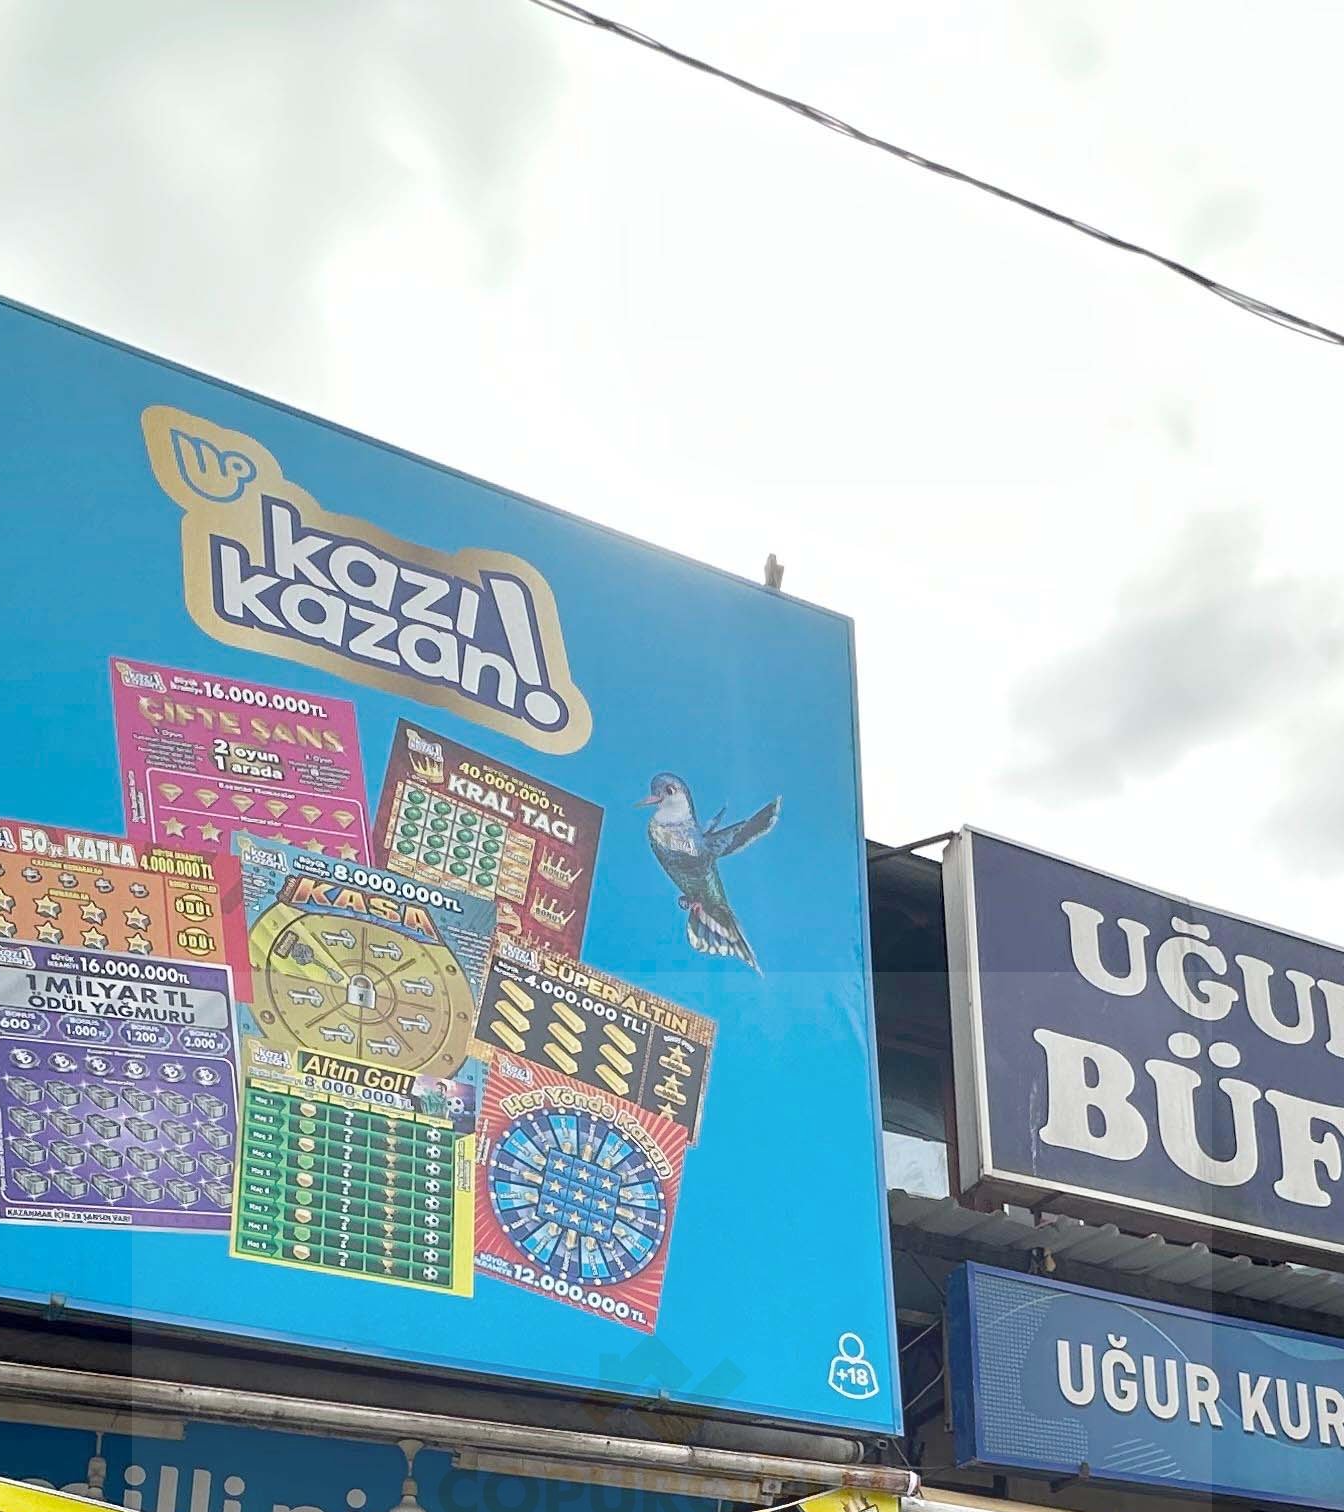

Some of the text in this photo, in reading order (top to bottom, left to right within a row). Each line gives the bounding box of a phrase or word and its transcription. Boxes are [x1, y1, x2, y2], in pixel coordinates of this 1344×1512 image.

[268, 500, 477, 636] kazı
[214, 739, 280, 764] 2 oyun
[214, 755, 225, 771] 1
[231, 764, 283, 781] arada
[459, 761, 550, 809] 40.000.000
[449, 774, 515, 819] KRAL
[521, 805, 577, 844] TACI
[67, 835, 137, 868] KATLA
[140, 854, 214, 881] 4.000.000 TL
[175, 898, 212, 918] ÖDÜL
[292, 878, 438, 940] KASA
[178, 931, 215, 950] ÖDÜL
[25, 974, 194, 1008] 1 MİLYAR TL
[28, 991, 195, 1024] ÖDÜL YAĞMURU
[524, 974, 648, 1035] 4.000.000 TL!
[543, 959, 688, 1034] SÜPER ALTIN
[0, 1018, 31, 1030] 600
[65, 1024, 98, 1038] 1.000
[126, 1030, 156, 1044] 1.200
[183, 1036, 216, 1049] 2.000
[303, 1055, 360, 1082] Altın
[364, 1068, 410, 1094] Gol!
[304, 1076, 395, 1105] 8.000.000
[504, 1088, 670, 1177] Her Yönde Kazan
[836, 1367, 869, 1388] +18
[1056, 1332, 1224, 1431] UĞUR
